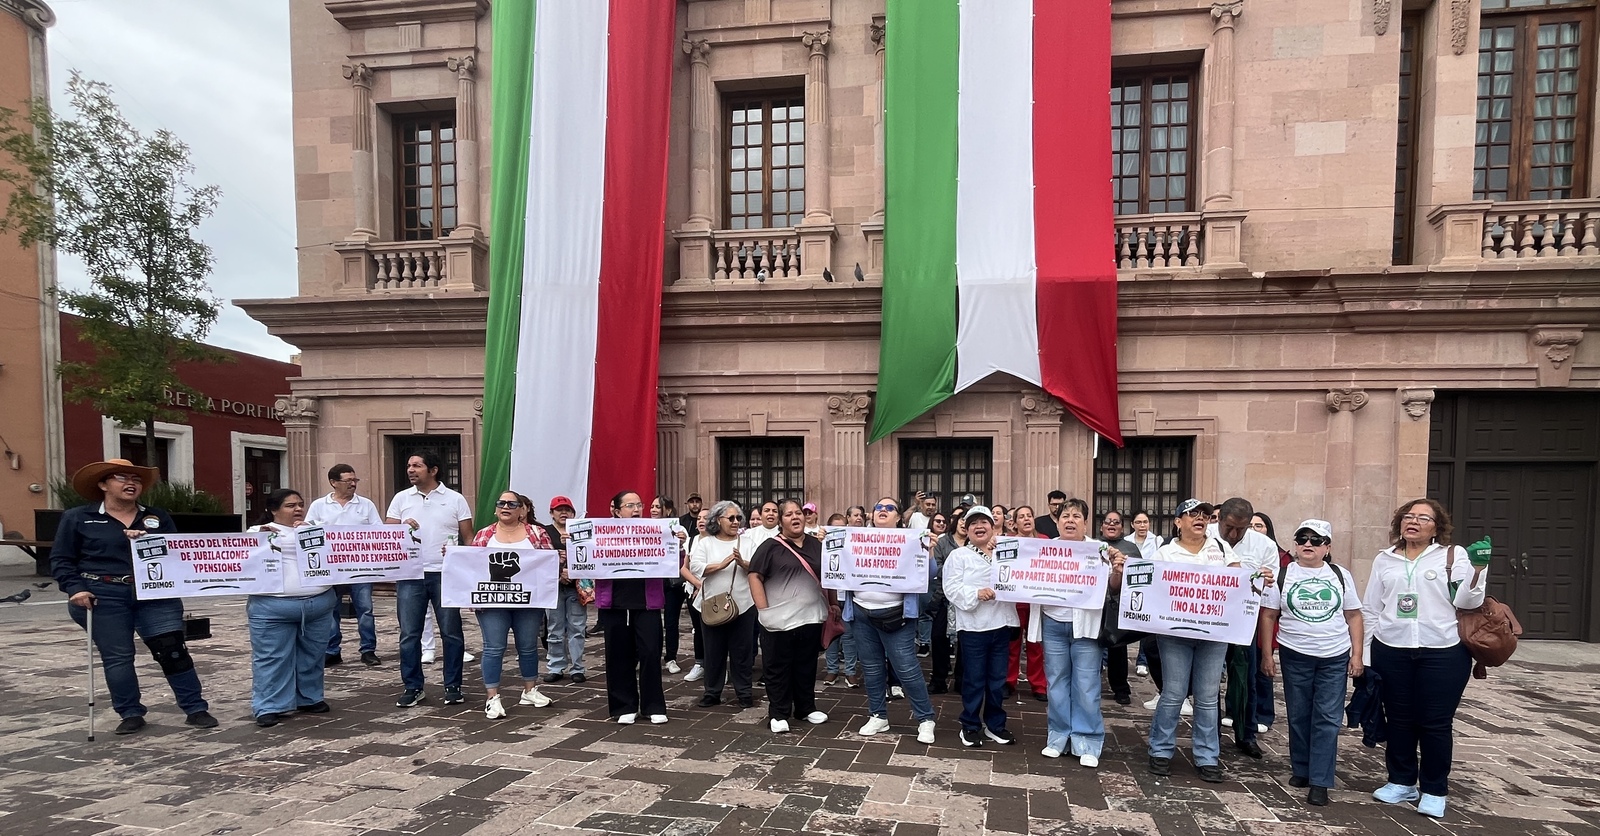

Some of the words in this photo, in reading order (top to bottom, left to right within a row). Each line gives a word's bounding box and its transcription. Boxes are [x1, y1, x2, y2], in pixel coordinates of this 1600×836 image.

[326, 532, 336, 540] NO
[337, 532, 342, 540] A
[343, 532, 355, 540] LOS
[356, 531, 391, 540] ESTATUTOS
[392, 531, 405, 540] QUE
[594, 526, 625, 535] INSUMOS
[626, 526, 631, 534] Y
[632, 526, 662, 534] PERSONAL
[168, 539, 205, 549] REGRESO
[208, 538, 222, 548] DEL
[223, 536, 259, 548] RÉGIMEN
[596, 538, 632, 547] SUFICIENTE
[633, 538, 640, 546] EN
[641, 537, 662, 546] TODAS
[886, 535, 906, 544] DIGNA
[332, 542, 371, 552] VIOLENTAN
[372, 542, 402, 551] NUESTRA
[864, 546, 877, 556] MAS
[878, 547, 901, 557] DINERO
[1039, 547, 1058, 558] ¡ALTO
[1059, 548, 1063, 556] A
[1064, 548, 1072, 558] LA
[181, 552, 191, 561] DE
[193, 550, 249, 561] JUBILACIONES
[327, 553, 361, 564] LIBERTAD
[362, 554, 370, 563] DE
[592, 549, 604, 558] LAS
[605, 549, 637, 558] UNIDADES
[638, 548, 665, 558] MEDICAS
[856, 559, 860, 567] A
[861, 559, 872, 568] LAS
[872, 560, 898, 570] AFORES!
[1030, 559, 1080, 571] INTIMIDACION
[1011, 570, 1024, 580] POR
[1025, 571, 1045, 582] PARTE
[1046, 573, 1057, 583] DEL
[1058, 574, 1098, 586] SINDICATO!
[1162, 570, 1200, 585] AUMENTO
[1202, 574, 1240, 588] SALARIAL
[479, 583, 521, 591] PROHIBIDO
[473, 593, 528, 603] RENDIRSE
[1170, 586, 1194, 599] DIGNO
[1196, 589, 1210, 600] DEL
[1212, 590, 1227, 602] 10%
[1190, 605, 1198, 614] AL
